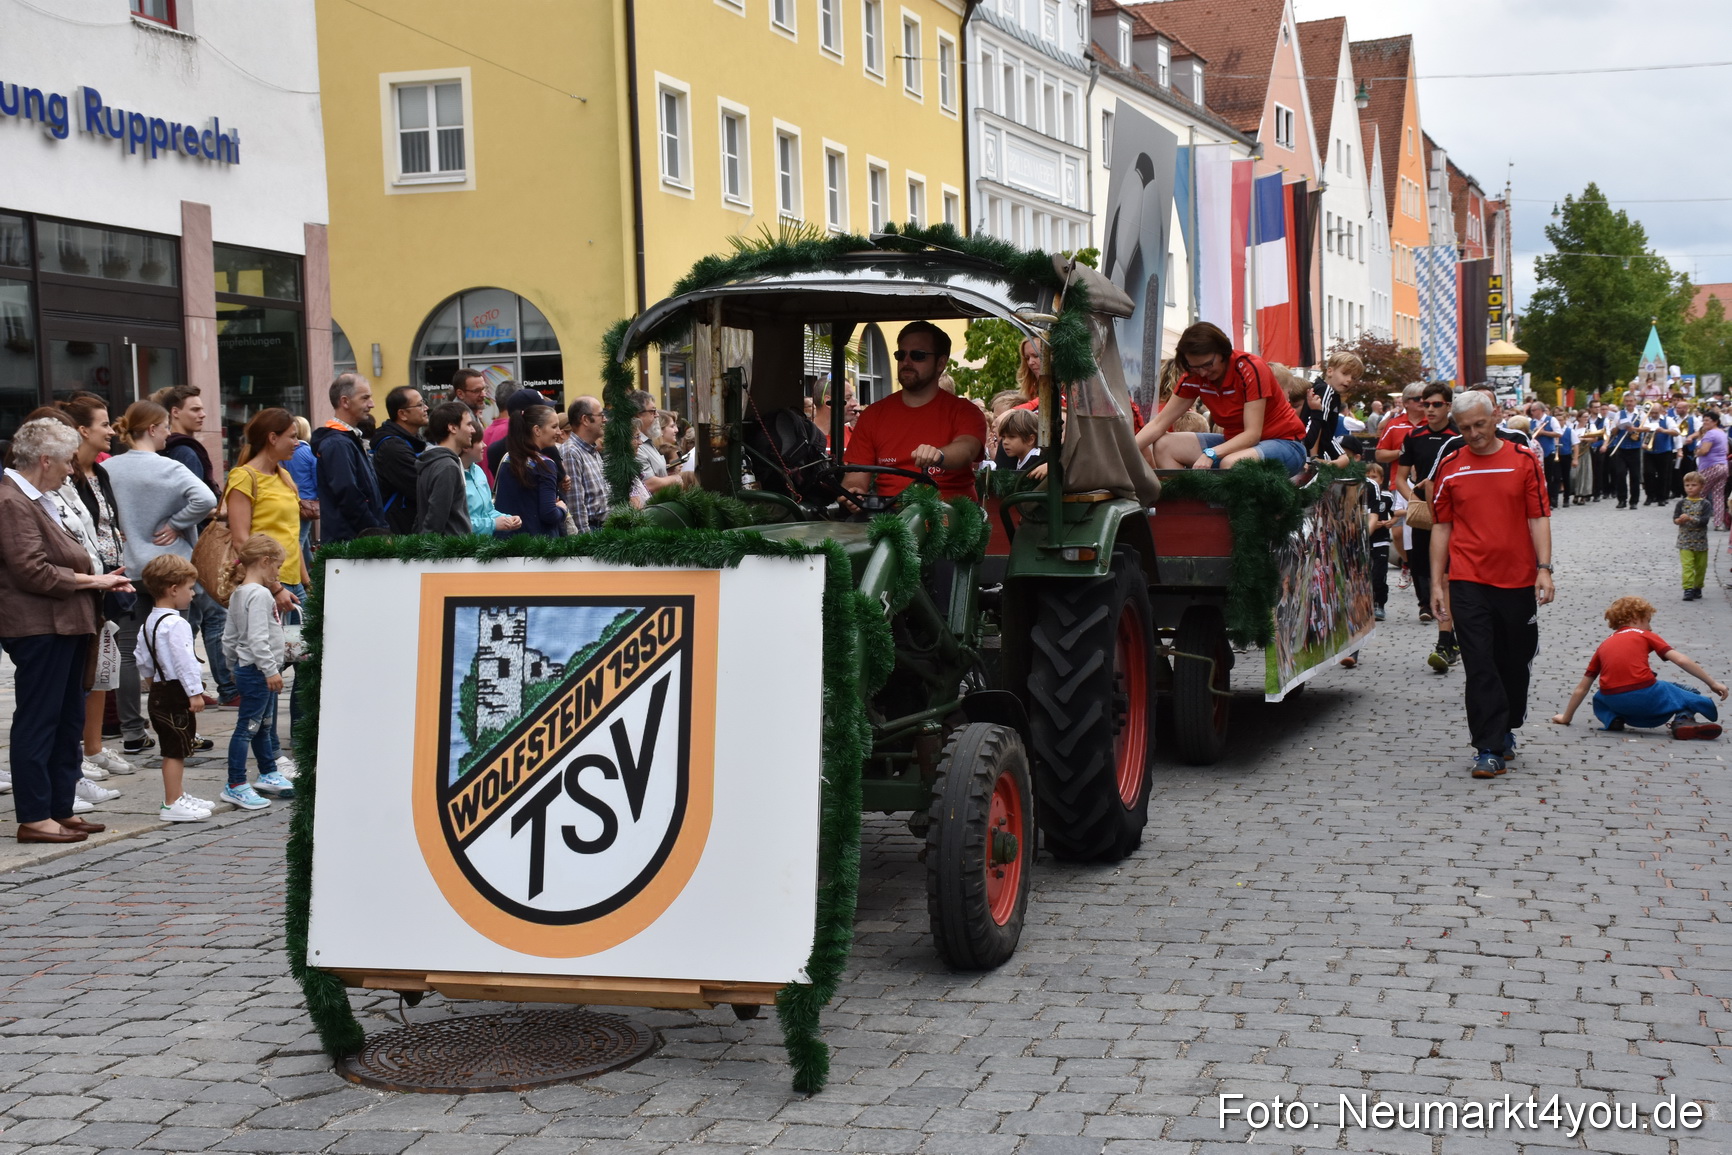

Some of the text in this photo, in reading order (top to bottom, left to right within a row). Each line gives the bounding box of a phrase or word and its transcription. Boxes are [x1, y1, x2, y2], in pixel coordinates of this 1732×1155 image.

[82, 86, 240, 164] Rupprecht
[472, 308, 500, 328] FOTO
[1488, 276, 1502, 339] HOTE
[450, 607, 677, 835] WOLFSTEIN 1950
[510, 670, 672, 901] TSV
